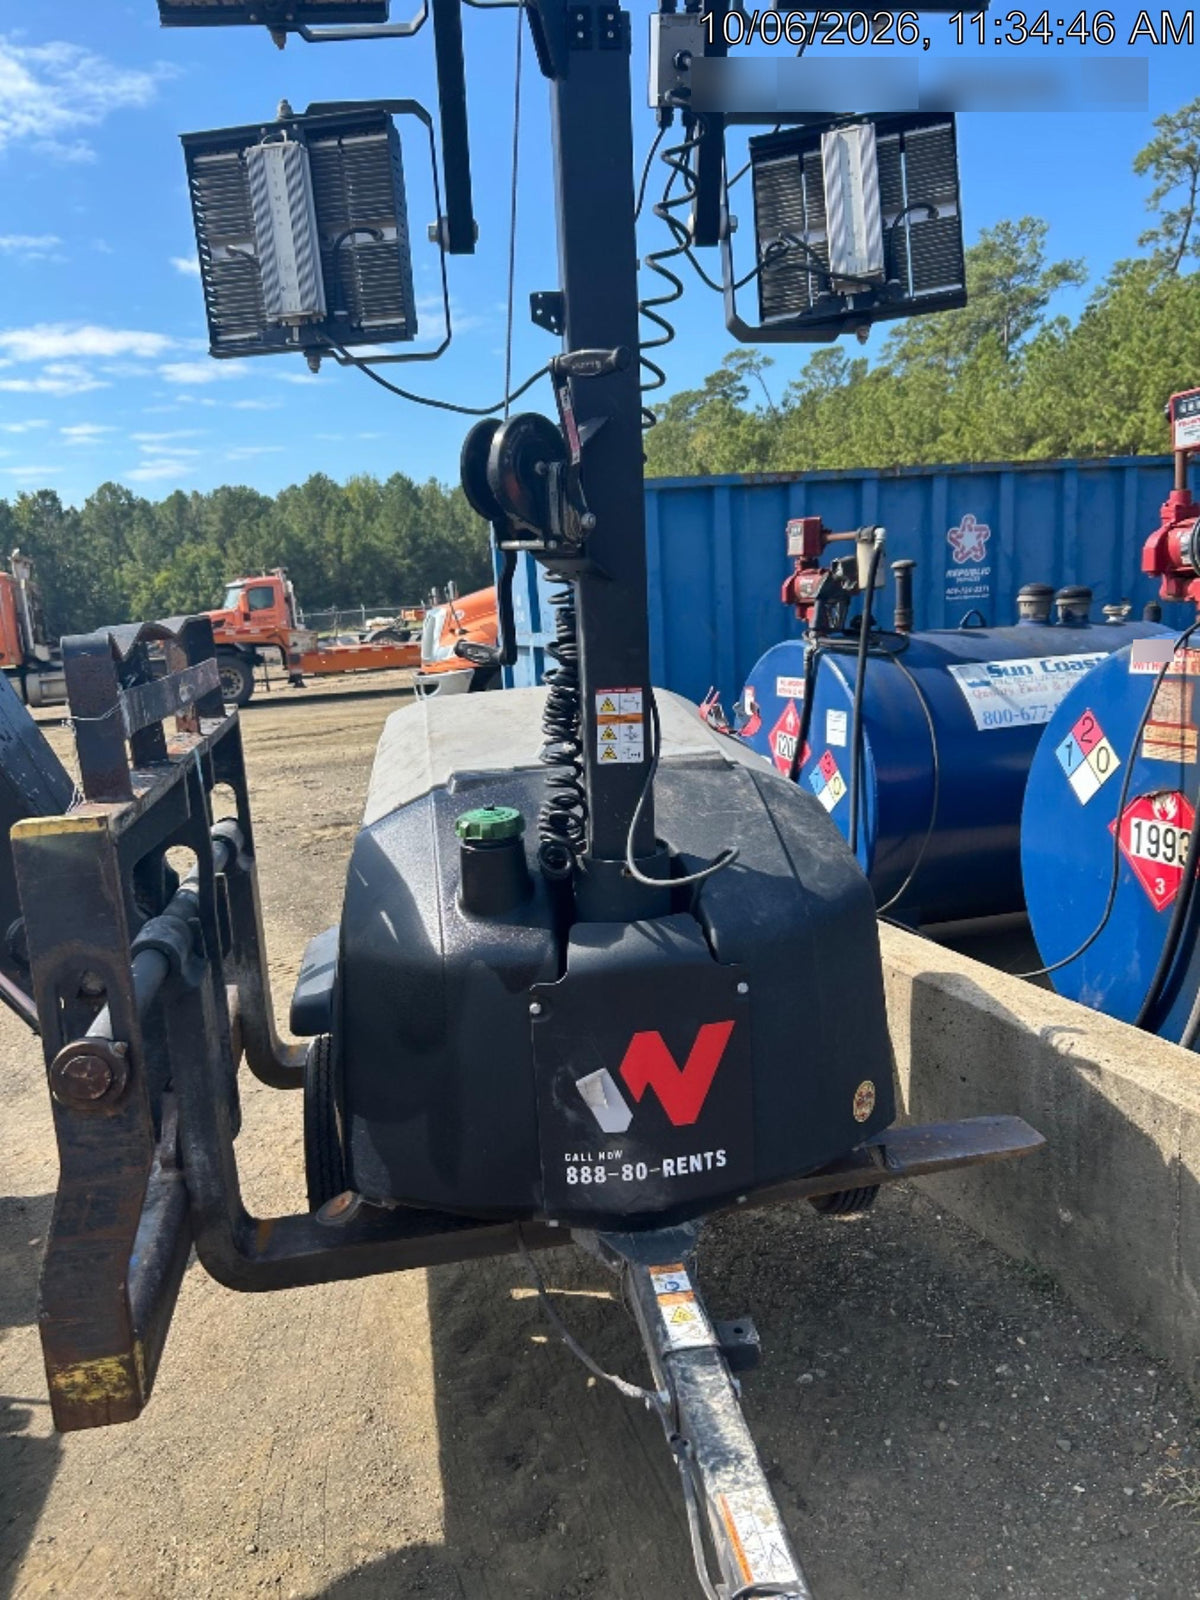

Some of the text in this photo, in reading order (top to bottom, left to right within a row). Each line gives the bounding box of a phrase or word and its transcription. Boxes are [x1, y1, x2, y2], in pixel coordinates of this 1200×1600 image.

[986, 664, 1034, 678] Sun
[1081, 716, 1094, 743] 2
[778, 733, 799, 759] 120
[1065, 741, 1073, 767] 1
[1096, 746, 1110, 773] 0
[1154, 877, 1165, 895] 3
[564, 1153, 593, 1162] CALL
[566, 1149, 727, 1184] 888-80-RENTS
